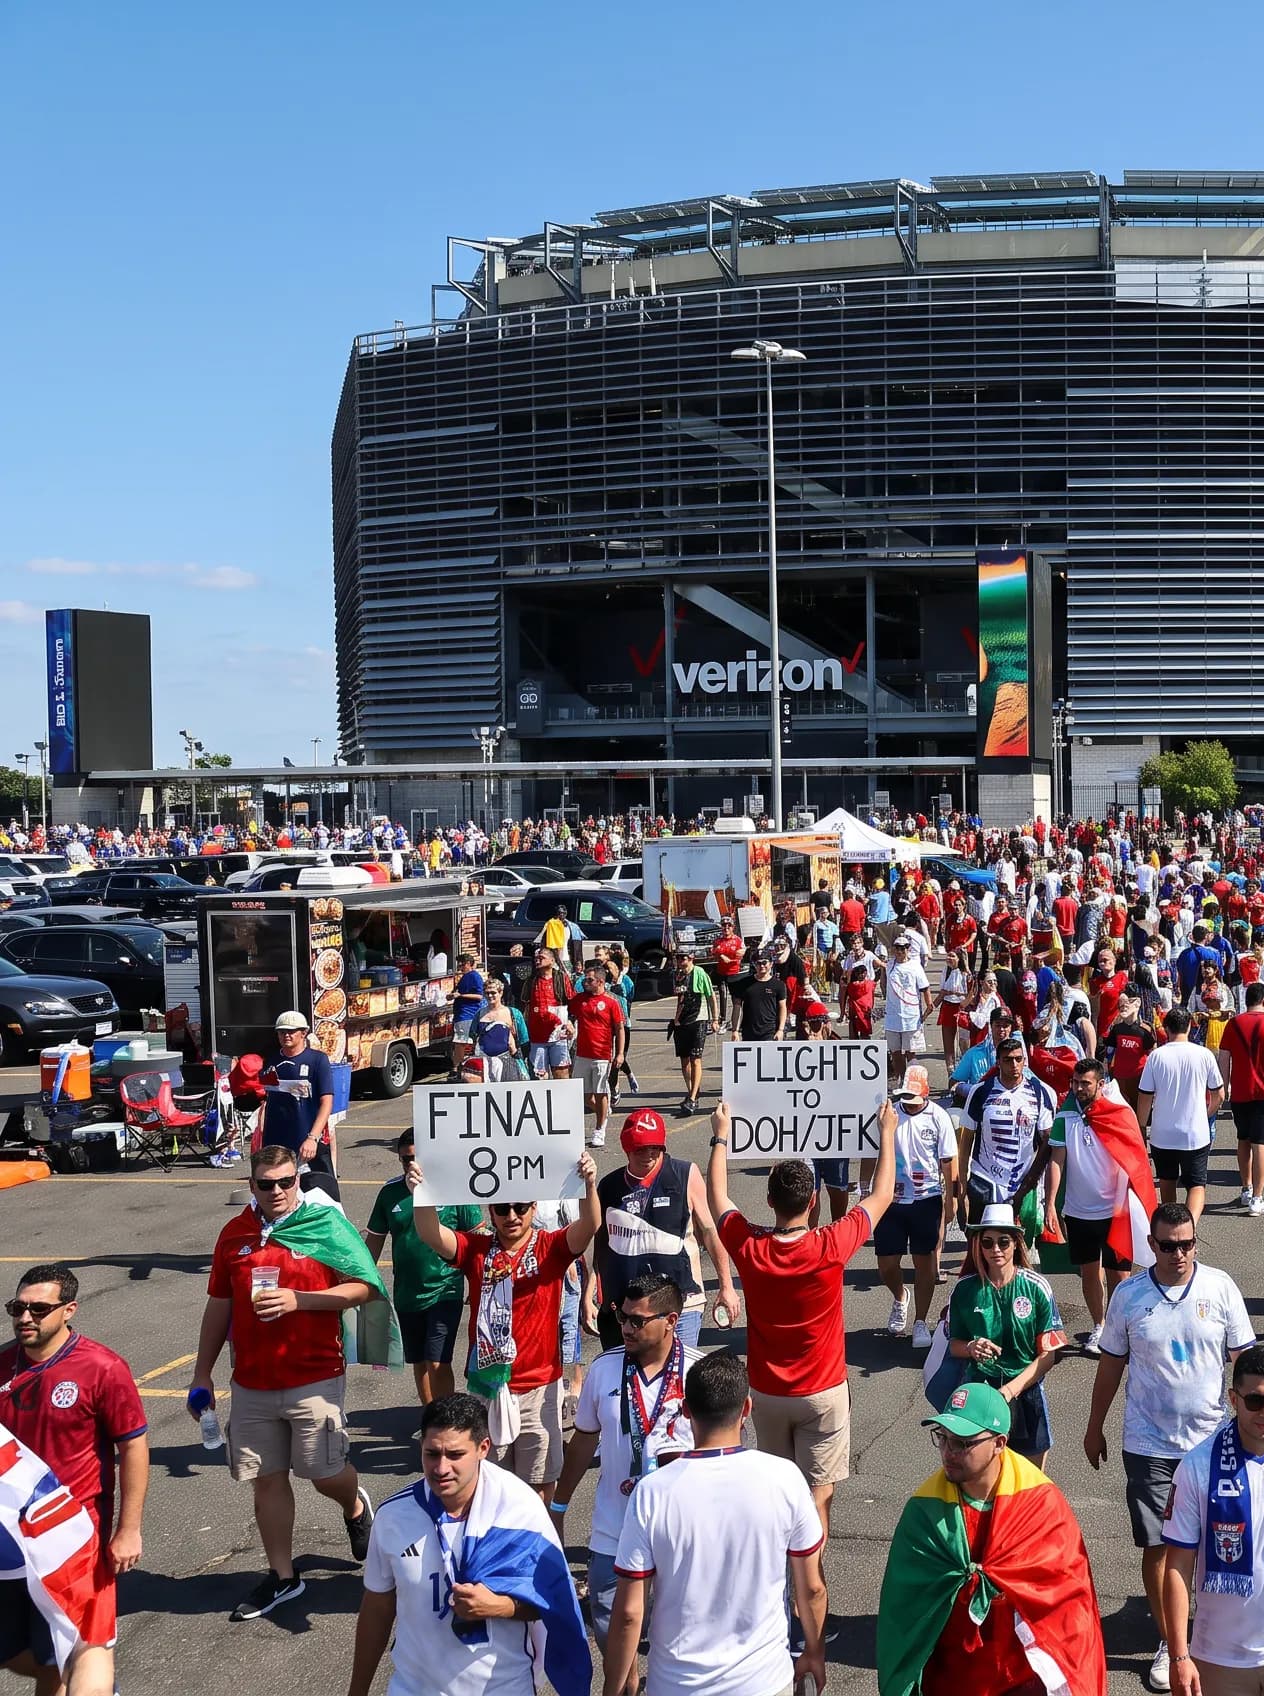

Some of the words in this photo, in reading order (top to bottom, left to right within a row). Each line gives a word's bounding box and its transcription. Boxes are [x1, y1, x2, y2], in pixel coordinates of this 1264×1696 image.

[672, 650, 843, 694] verizon
[733, 1044, 880, 1084] FLIGHTS
[428, 1089, 571, 1140] FINAL
[786, 1088, 821, 1109] TO
[730, 1112, 880, 1154] DOH/JFK
[468, 1146, 501, 1199] 8
[507, 1154, 545, 1181] PM
